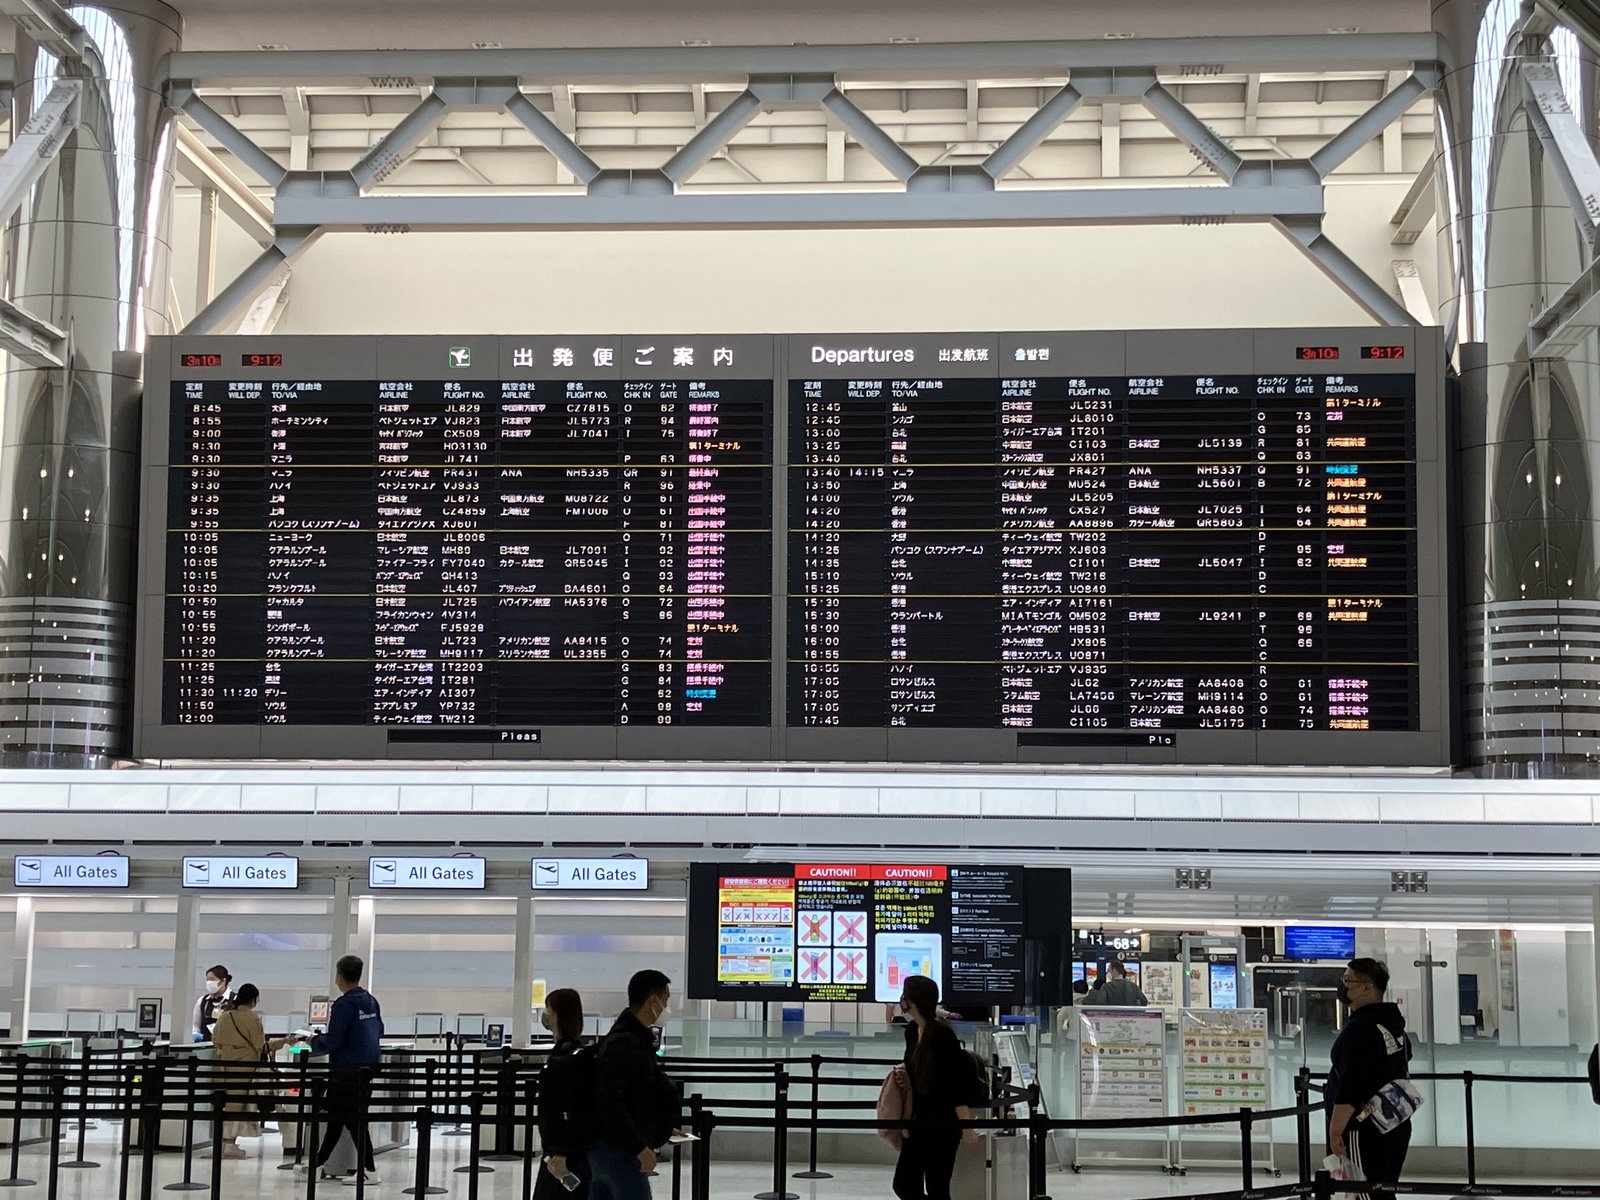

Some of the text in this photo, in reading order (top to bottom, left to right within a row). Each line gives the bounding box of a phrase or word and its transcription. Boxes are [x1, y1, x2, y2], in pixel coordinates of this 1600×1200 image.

[514, 347, 732, 366] 出発便ご案内
[812, 347, 914, 365] Departures
[939, 349, 988, 361] 出发航班
[1015, 349, 1049, 360] 출발편
[1371, 347, 1403, 359] 9:12
[251, 355, 281, 367] 9:12
[1002, 380, 1036, 388] 航空会社
[1197, 378, 1213, 388] 便名
[1297, 412, 1311, 420] 73
[445, 417, 479, 425] VJ823
[806, 427, 1104, 437] 13:00 IT201
[806, 455, 840, 463] 13:40
[851, 468, 883, 476] 14:15
[1069, 480, 1105, 488] MU524
[1297, 479, 1311, 487] 72
[185, 533, 218, 541] 10:05
[659, 533, 671, 541] 71
[1070, 532, 1265, 541] TW202 D
[184, 546, 217, 554] 10:05
[1259, 545, 1265, 553] F
[565, 559, 607, 567] QR5045
[1069, 559, 1104, 567] CI101
[806, 572, 839, 580] 15:10
[183, 584, 216, 592] 10:20
[805, 585, 839, 593] 15:25
[443, 598, 476, 606] JL725
[660, 598, 672, 606] 72
[623, 611, 628, 619] S
[1069, 612, 1266, 620] OM502 P
[442, 637, 476, 645] JL723
[564, 650, 606, 658] UL3355
[442, 663, 483, 671] IT2203
[224, 689, 257, 697] 11:20
[440, 689, 475, 697] AI307
[621, 689, 628, 697] C
[180, 701, 213, 709] 11:50
[440, 702, 474, 710] YP732
[1299, 706, 1313, 714] 74
[180, 714, 213, 722] 12:00
[440, 715, 474, 723] TW212
[502, 732, 537, 740] Pleas
[54, 865, 117, 878] All Gates
[223, 867, 286, 879] All Gates
[409, 867, 473, 879] All Gates
[572, 868, 636, 880] All Gates
[810, 868, 856, 877] CAUTION!!
[885, 869, 932, 878] CAUTION!!
